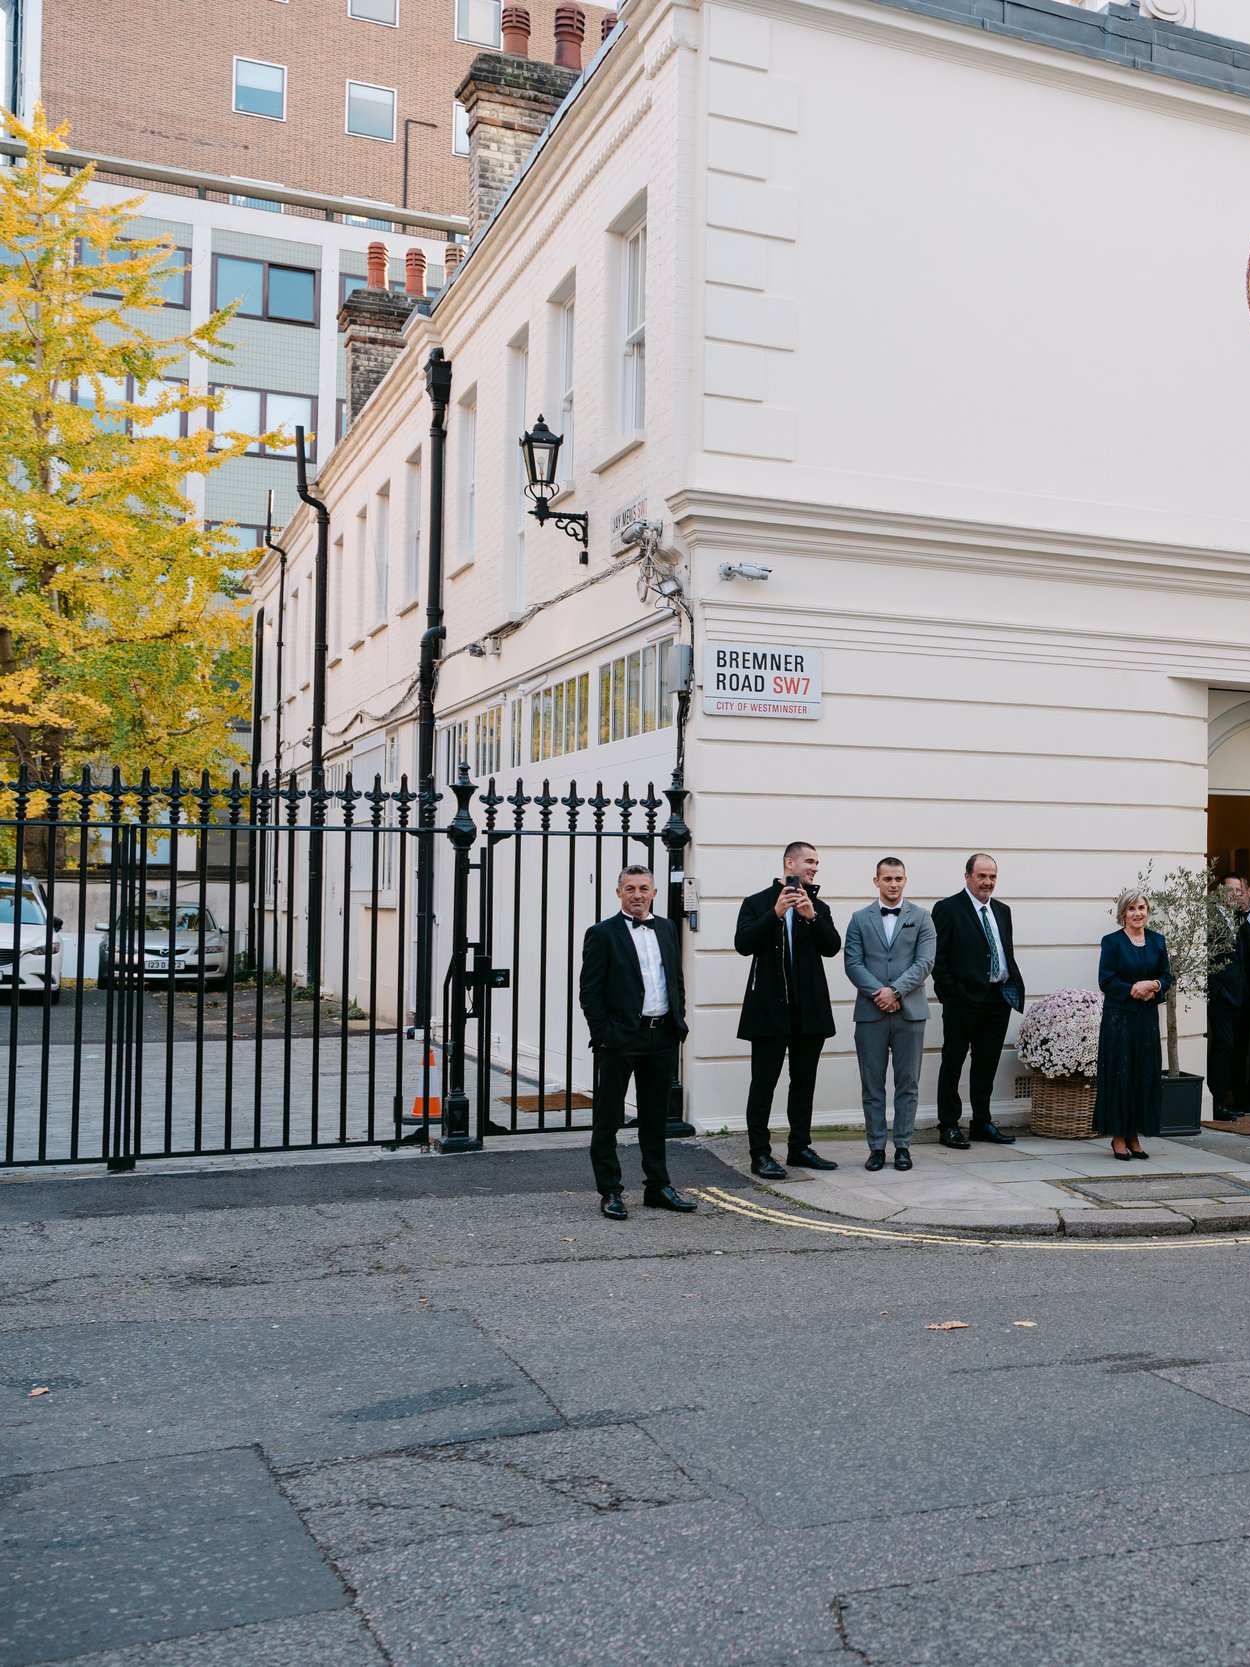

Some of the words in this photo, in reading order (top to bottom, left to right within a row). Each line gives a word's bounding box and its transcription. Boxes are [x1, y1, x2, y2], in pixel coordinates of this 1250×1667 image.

[716, 650, 804, 672] BREMNER
[716, 673, 765, 692] ROAD
[773, 676, 810, 695] SW7
[716, 702, 735, 711] CITY
[737, 702, 747, 711] OF
[750, 703, 808, 714] WESTMINSTER
